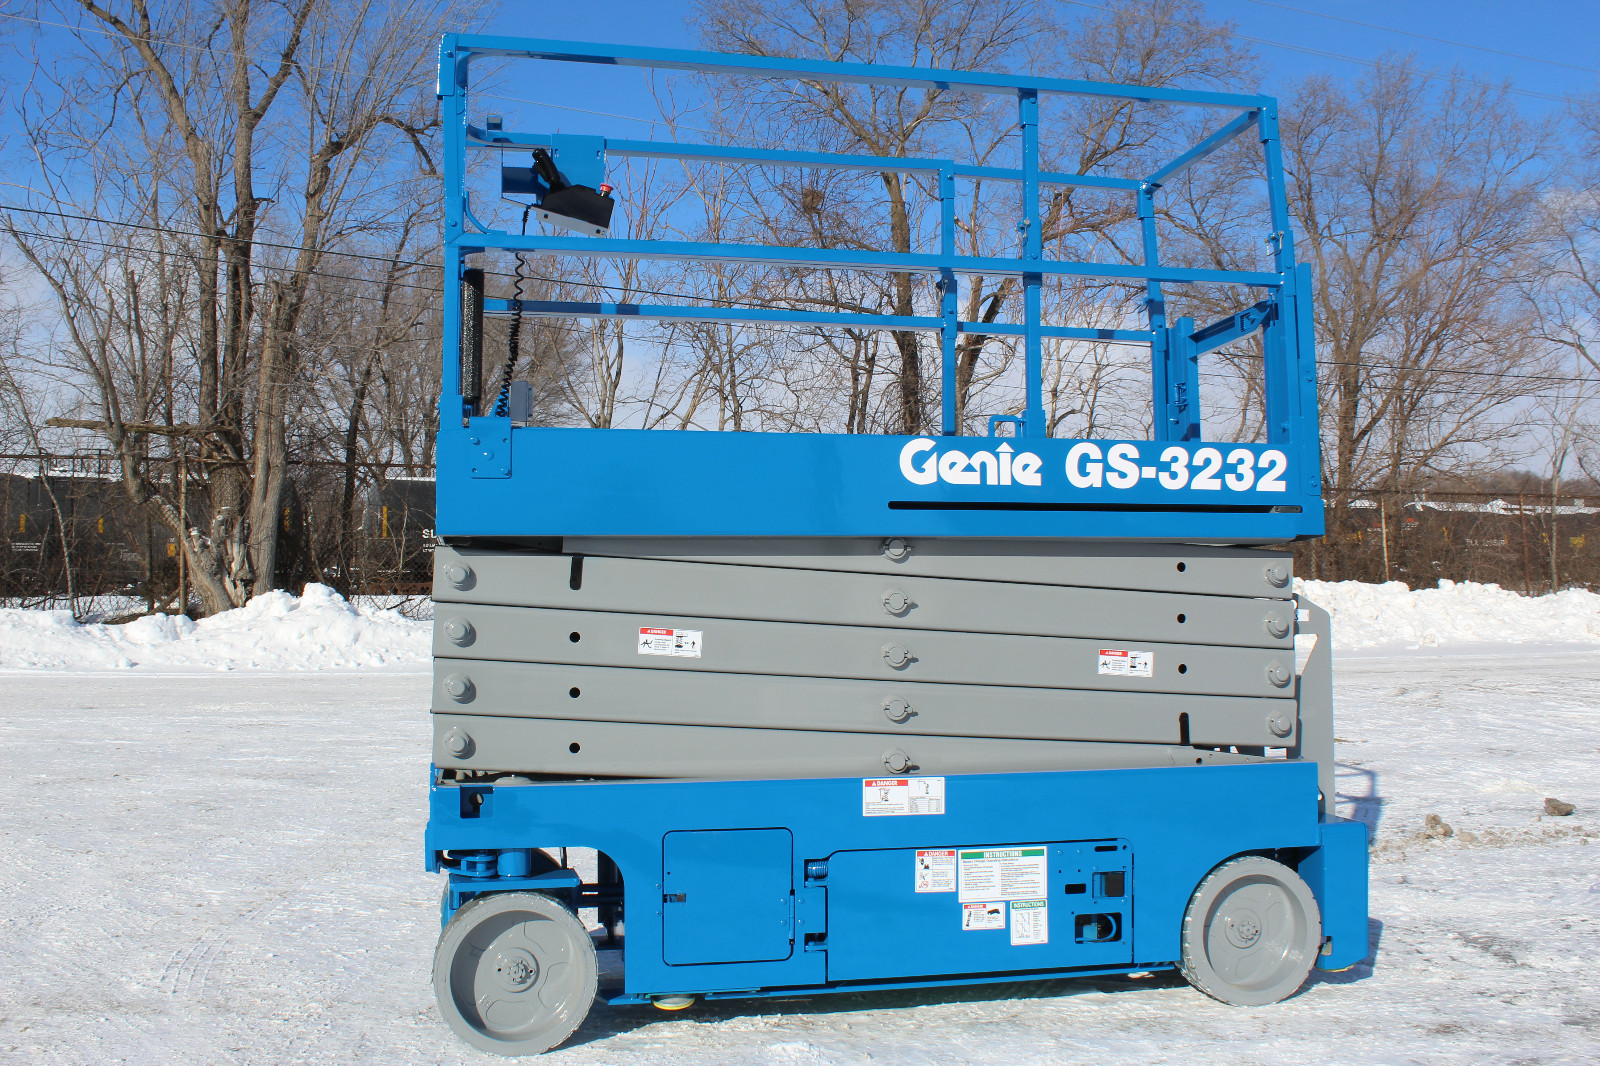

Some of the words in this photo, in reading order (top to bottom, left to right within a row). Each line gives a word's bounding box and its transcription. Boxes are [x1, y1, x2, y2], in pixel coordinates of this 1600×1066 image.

[899, 437, 1042, 486] Genie
[1065, 442, 1287, 492] GS-3232
[983, 850, 1023, 858] INSTRUCTIONS
